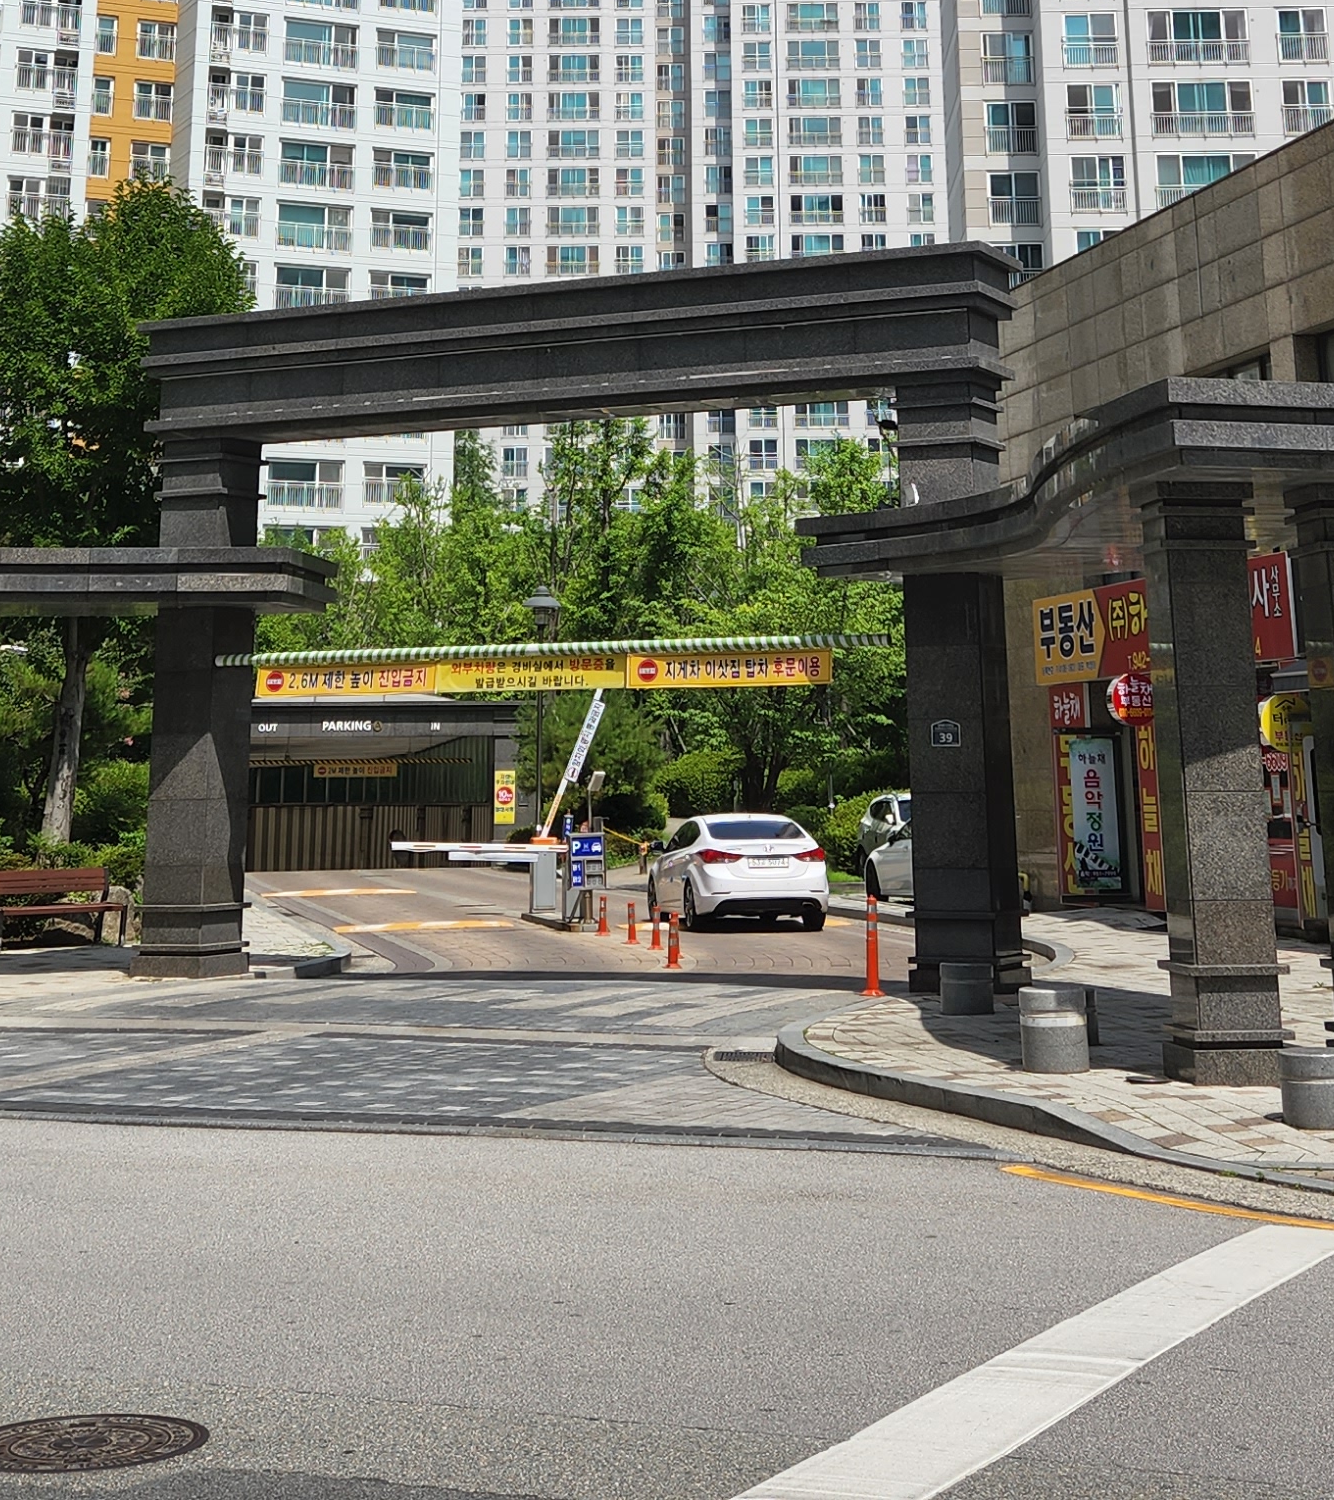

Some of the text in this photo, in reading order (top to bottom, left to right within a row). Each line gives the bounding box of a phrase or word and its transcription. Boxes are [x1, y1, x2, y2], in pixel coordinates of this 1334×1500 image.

[1270, 565, 1282, 617] 사무소
[1038, 599, 1095, 660] 부동산
[451, 657, 615, 675] 외부차량은 경비실에서 방문증을
[665, 656, 820, 680] 지게차 이삿짐 탑차 후문이용
[322, 671, 347, 689] 제한
[350, 670, 374, 689] 높이
[378, 669, 427, 688] 진입금지
[475, 674, 589, 688] 발급받으시길 바랍니다.
[1053, 692, 1080, 726] 하늘채
[1121, 695, 1152, 707] 부동산
[258, 721, 441, 732] OUT PARKING IN
[939, 732, 953, 743] 39
[1078, 753, 1106, 765] 하늘채
[367, 765, 392, 775] 진입금지
[1083, 768, 1105, 852] 음악정원
[1137, 726, 1163, 896] 하늘채
[572, 841, 581, 854] P
[572, 864, 581, 872] B1
